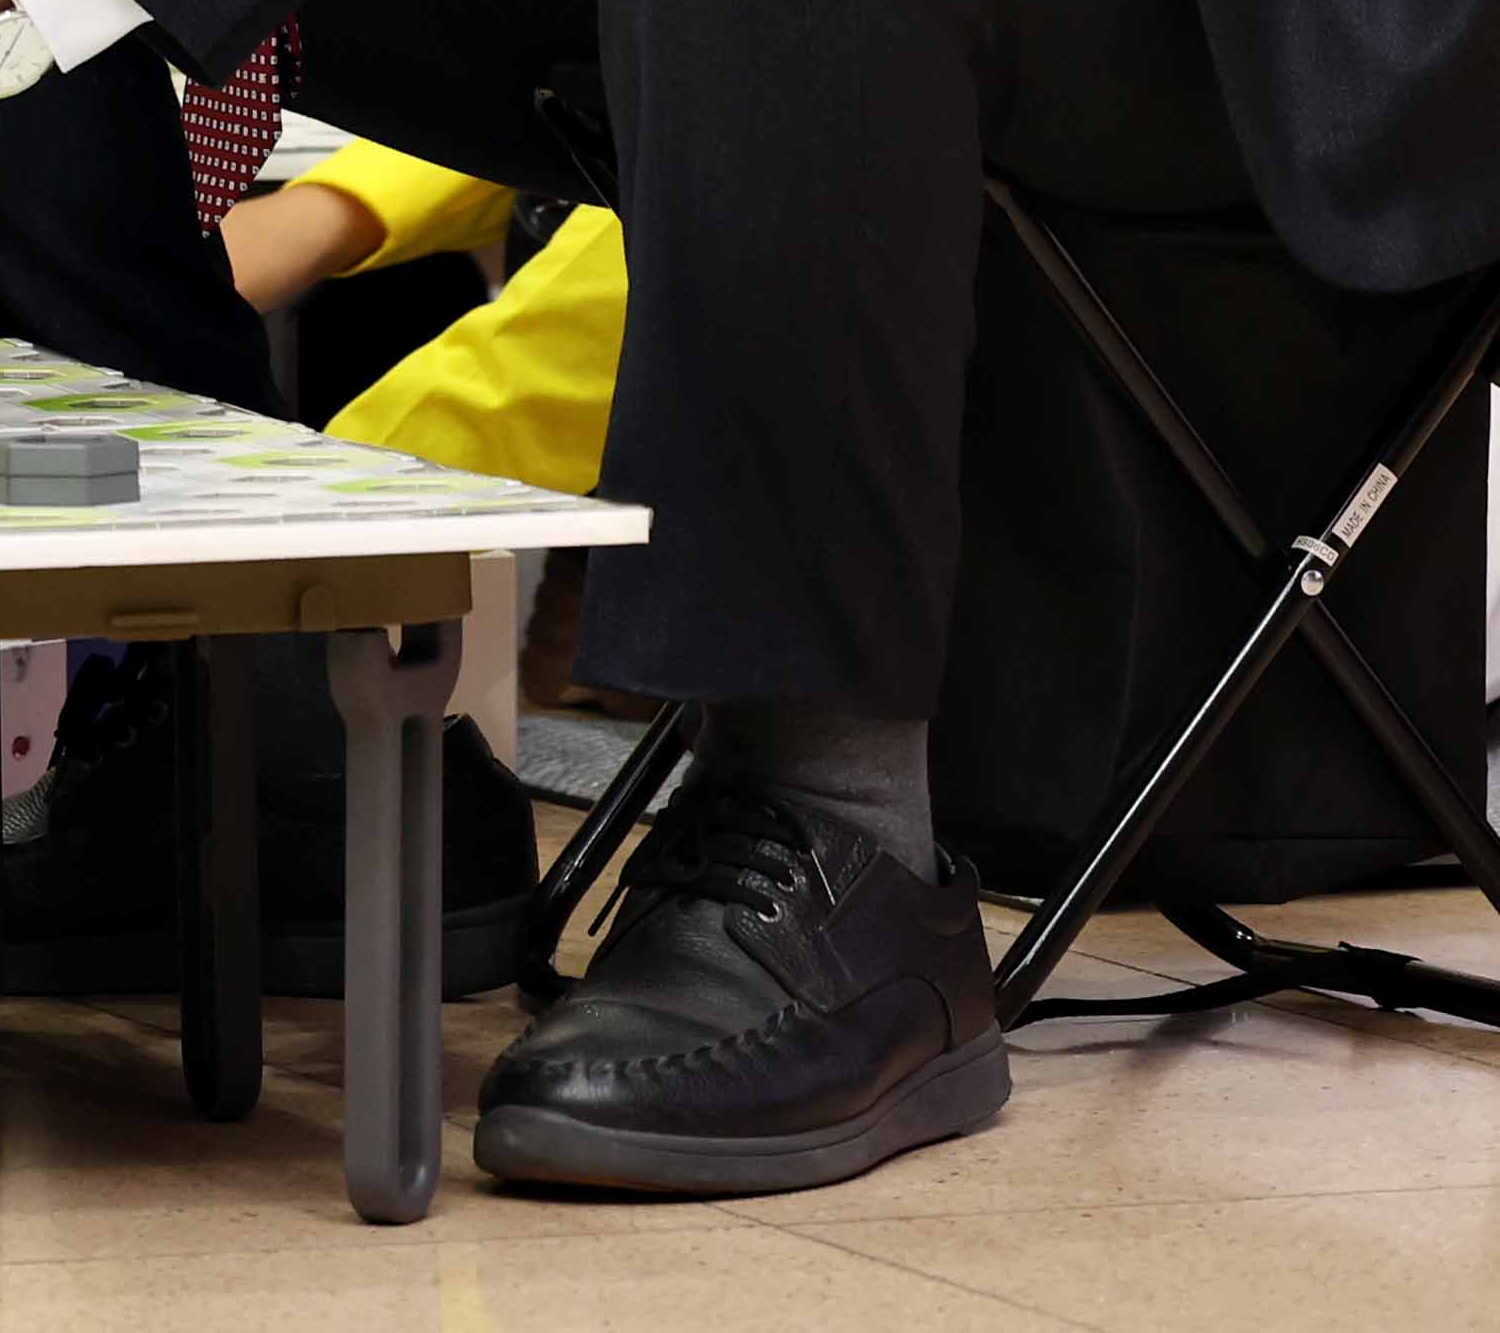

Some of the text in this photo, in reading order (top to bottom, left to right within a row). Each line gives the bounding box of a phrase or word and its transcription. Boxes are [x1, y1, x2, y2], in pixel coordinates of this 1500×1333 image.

[1341, 473, 1390, 538] MADE IN CHINA
